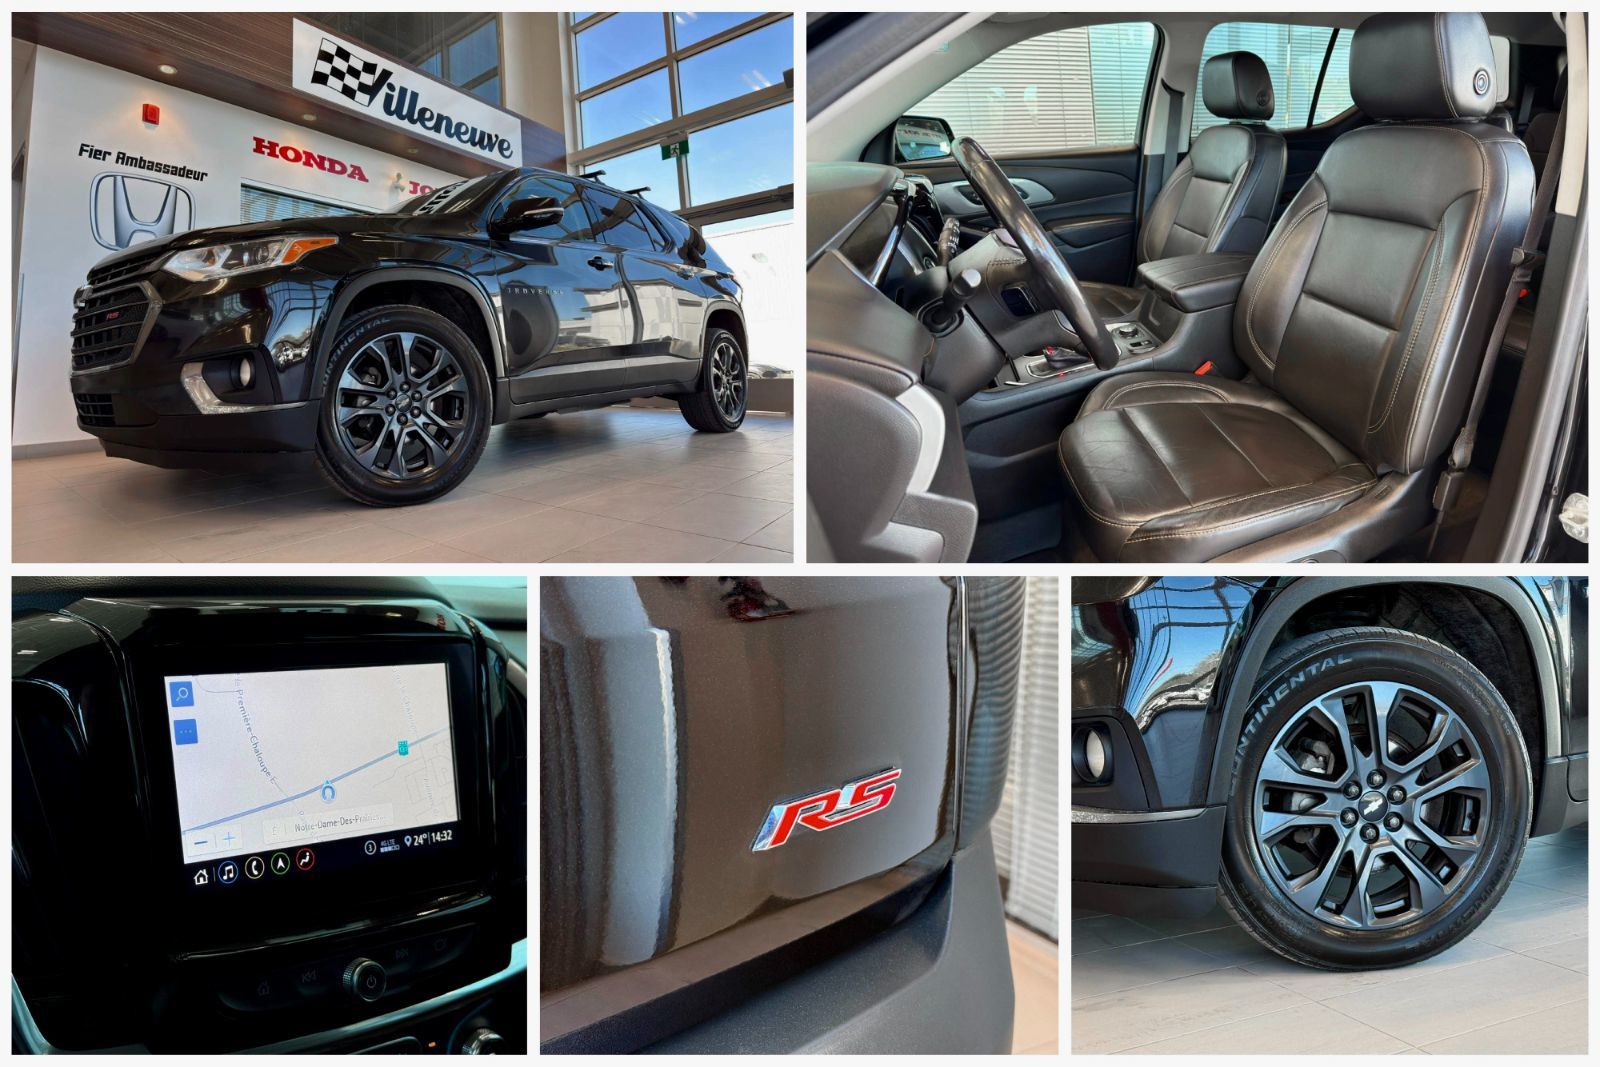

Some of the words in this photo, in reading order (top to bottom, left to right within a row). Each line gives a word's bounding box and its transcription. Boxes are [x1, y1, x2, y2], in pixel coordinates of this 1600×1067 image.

[364, 67, 513, 159] Villeneuve
[78, 143, 112, 161] Fier
[115, 151, 208, 182] Ambassadeur
[252, 136, 369, 183] HONDA
[409, 180, 438, 196] JO
[753, 767, 902, 851] RS
[413, 833, 428, 846] 24°
[431, 829, 453, 843] 14:32
